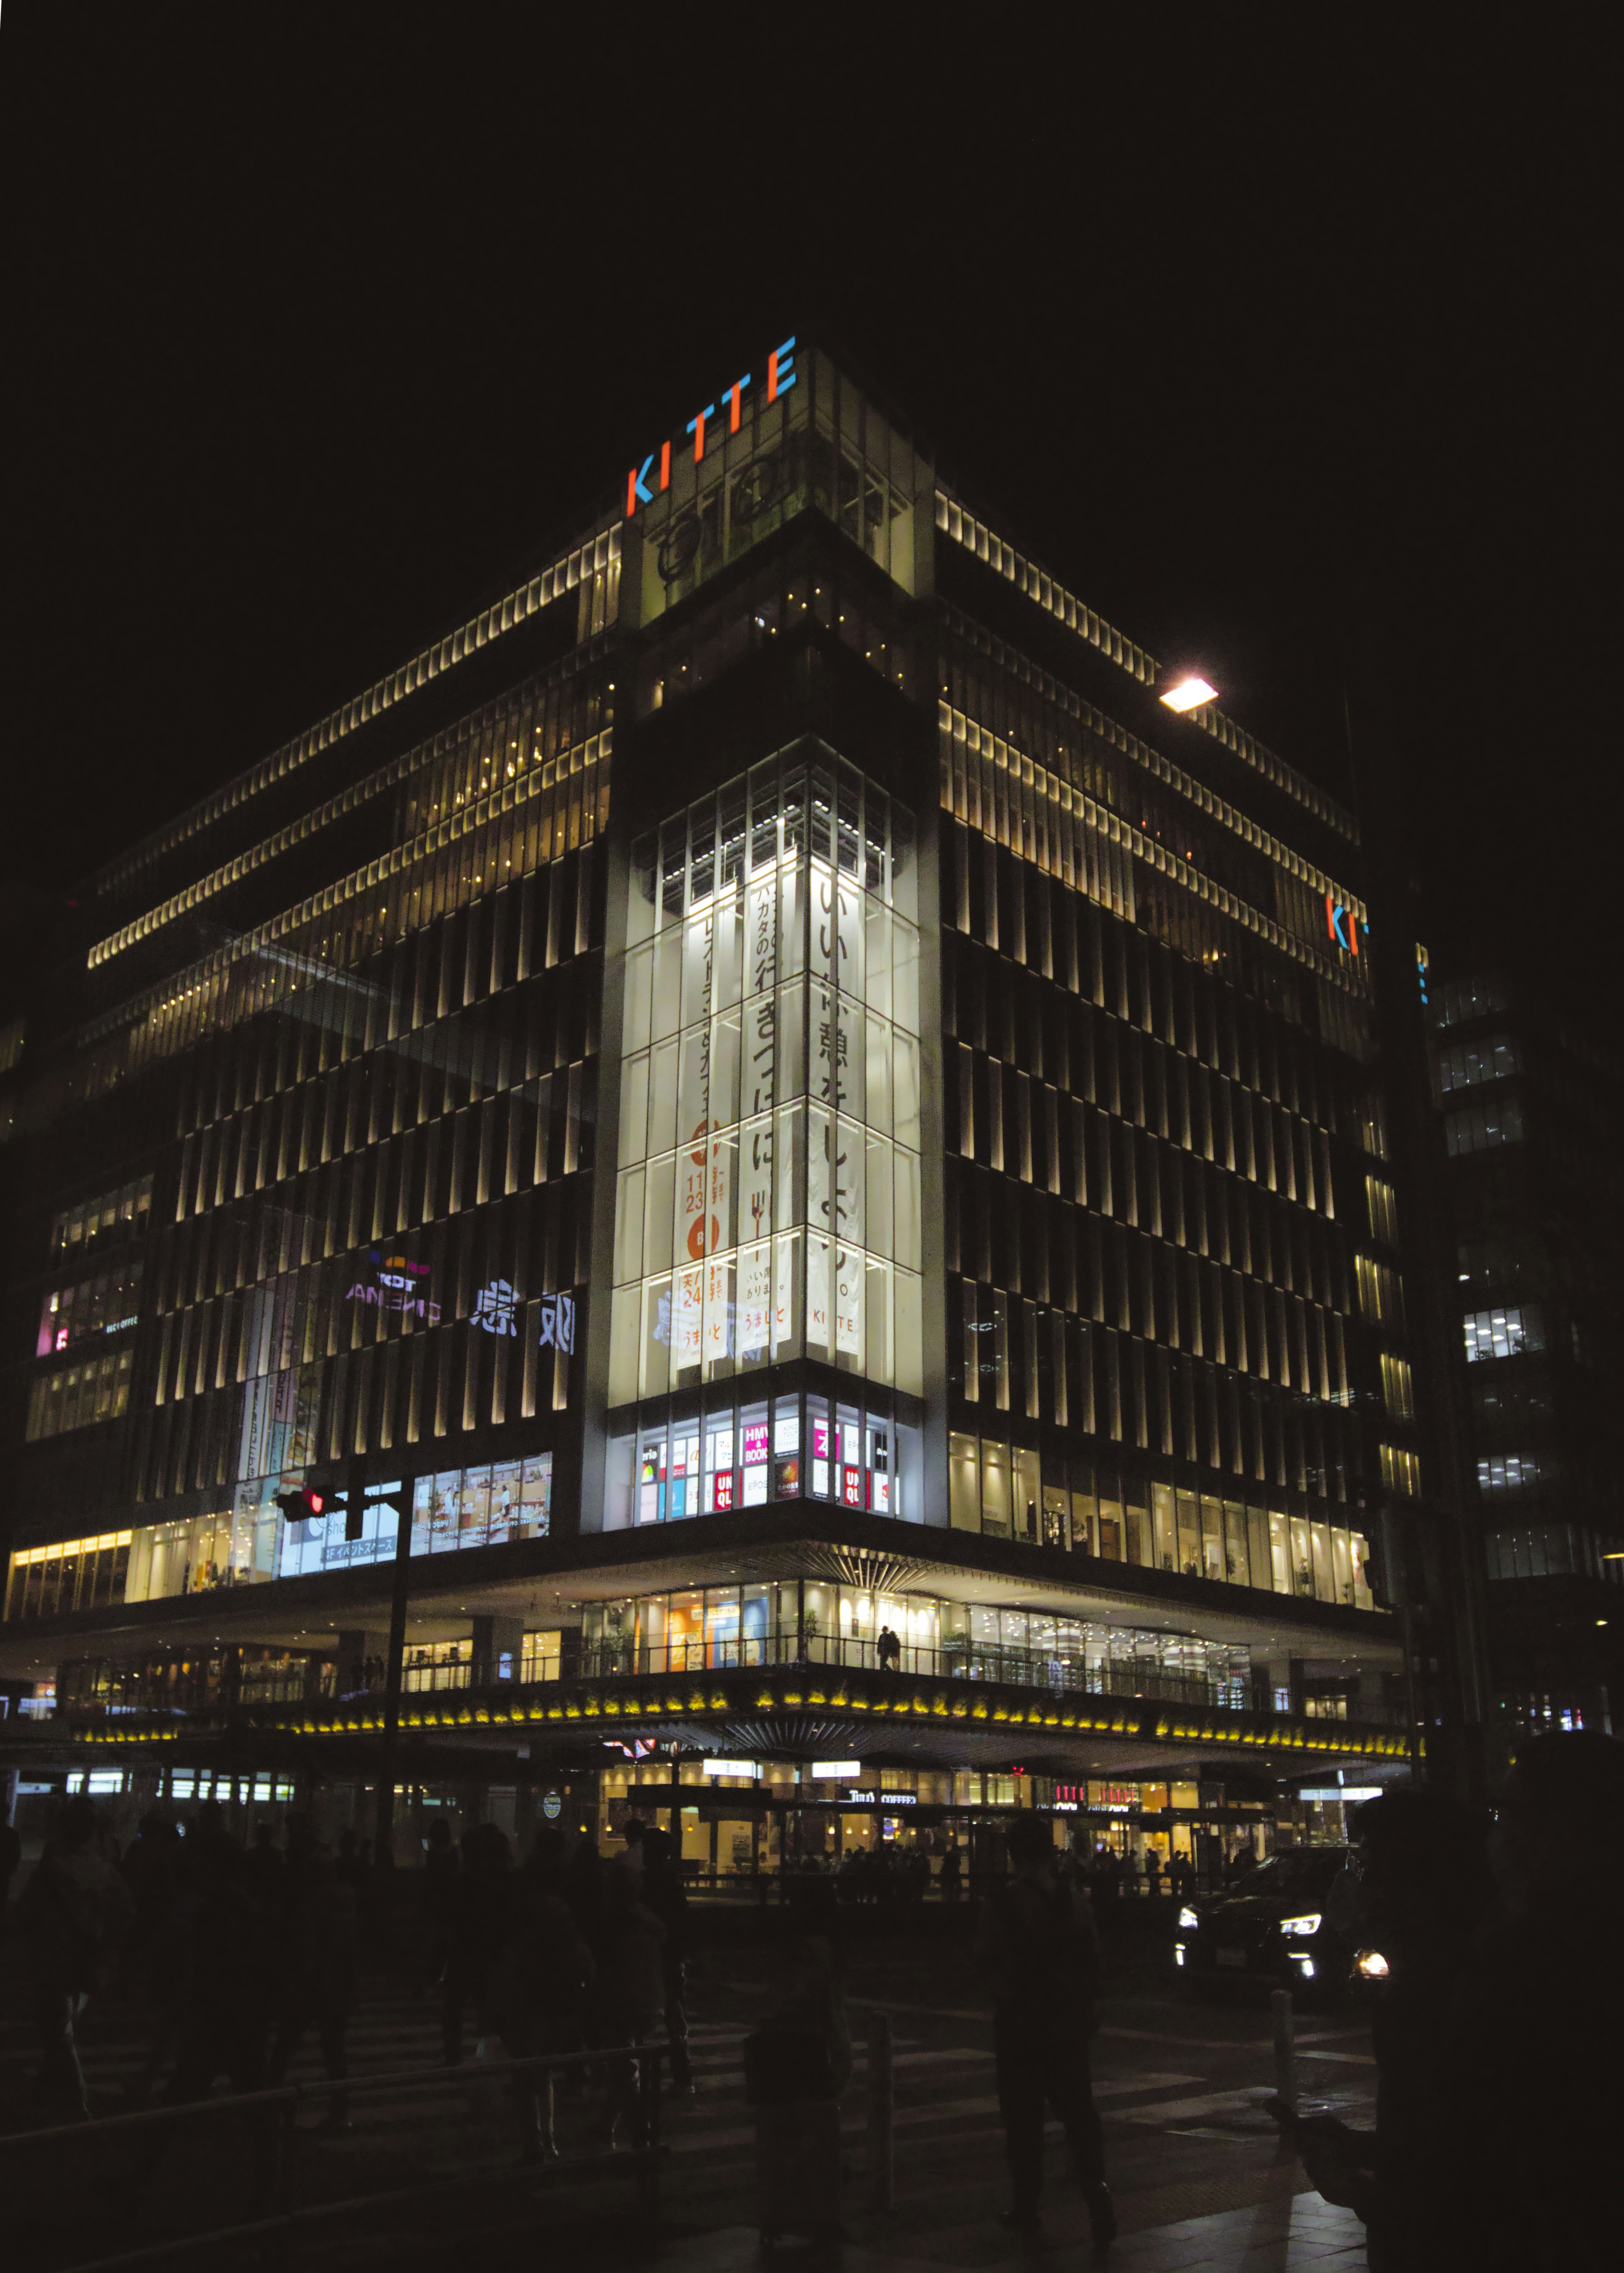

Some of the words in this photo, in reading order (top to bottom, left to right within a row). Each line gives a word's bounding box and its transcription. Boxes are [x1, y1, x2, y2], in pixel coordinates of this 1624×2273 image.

[627, 335, 796, 518] KITTE
[746, 1282, 784, 1300] ありま。
[814, 1309, 853, 1332] KITE
[683, 1323, 721, 1349] うまと
[782, 1430, 798, 1438] TULP
[756, 1440, 761, 1448] &
[642, 1449, 657, 1461] eria
[662, 1450, 685, 1459] domo
[721, 1452, 732, 1460] アニ
[745, 1448, 768, 1463] BOOK
[718, 1475, 732, 1490] UN
[847, 1471, 859, 1487] UN
[718, 1491, 732, 1507] QL
[847, 1487, 859, 1504] QL
[327, 1521, 345, 1536] sho
[337, 1539, 392, 1559] イベントスース
